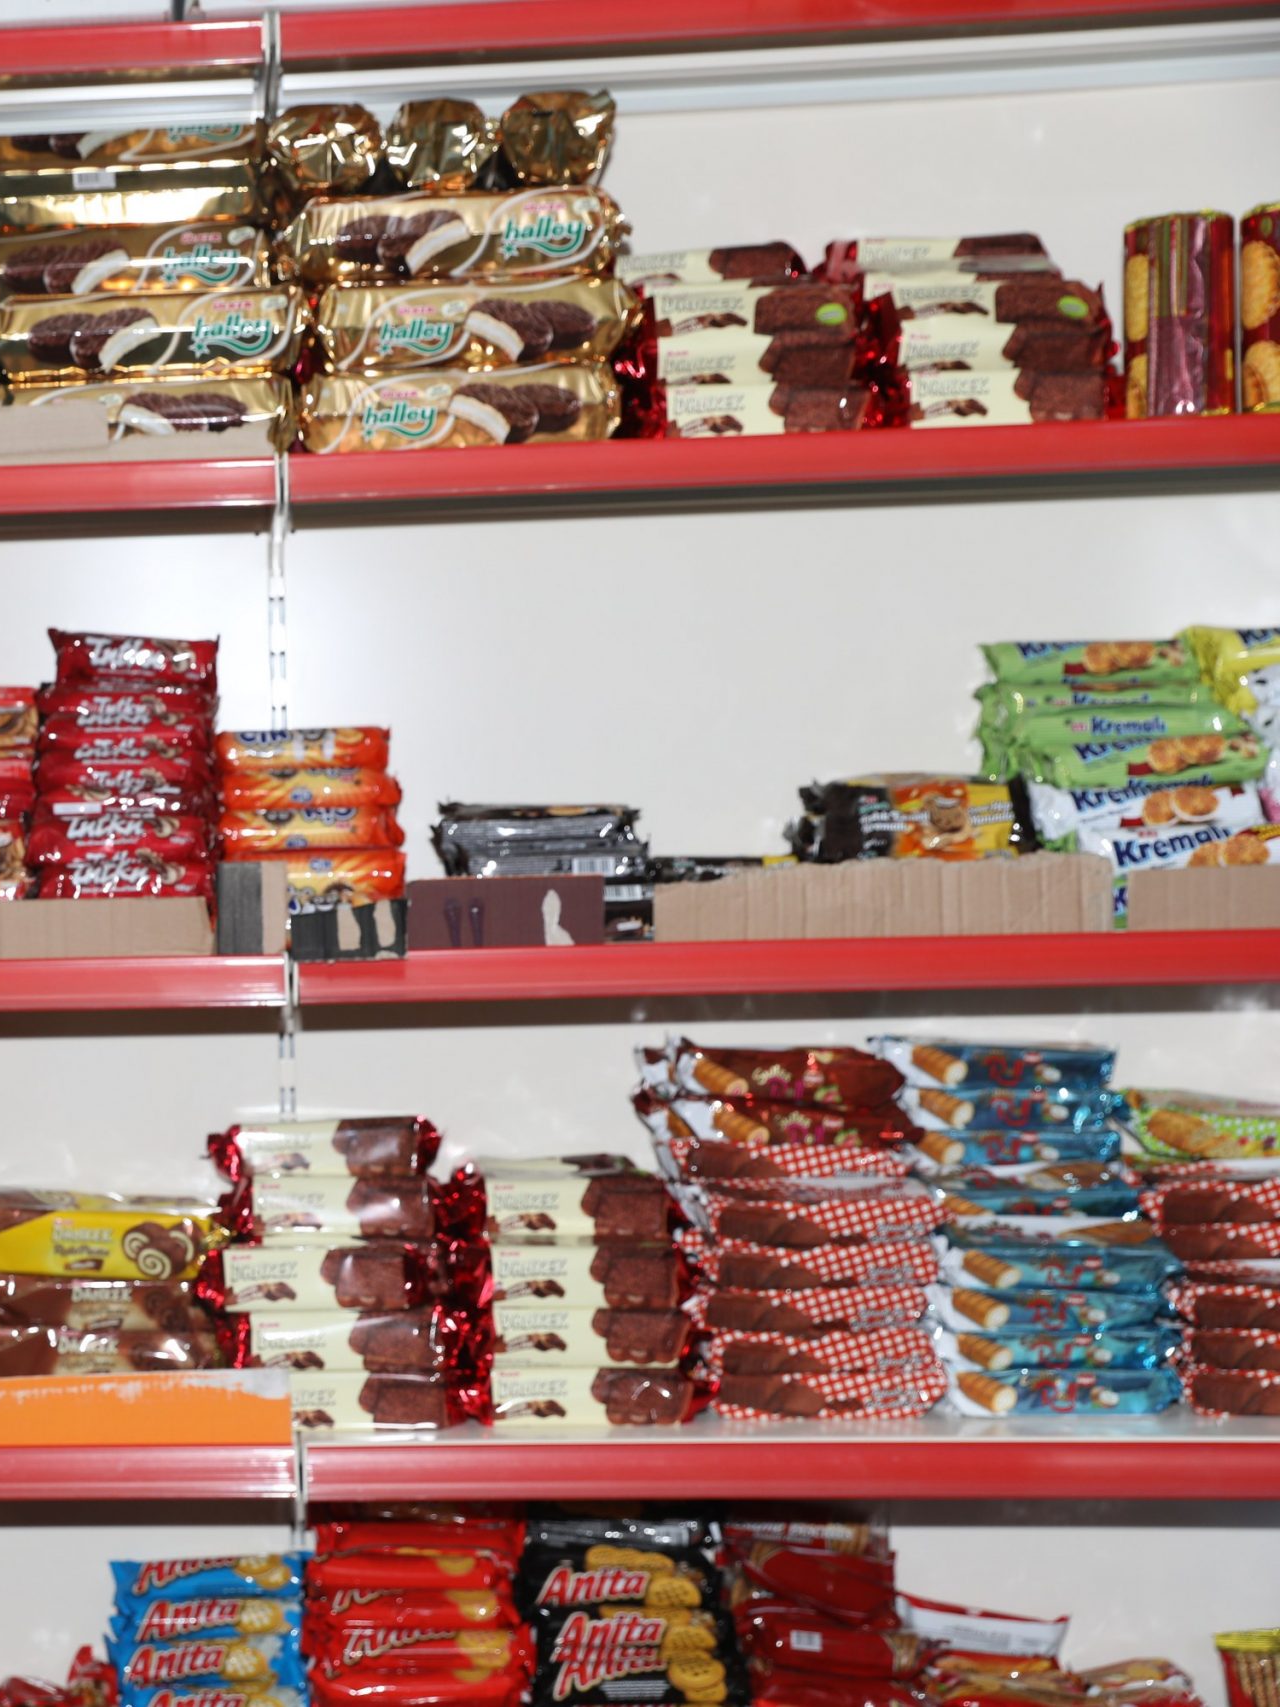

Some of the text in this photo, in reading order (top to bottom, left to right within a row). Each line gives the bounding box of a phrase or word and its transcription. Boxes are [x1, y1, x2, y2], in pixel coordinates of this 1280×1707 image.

[504, 215, 587, 258] halley
[194, 312, 272, 356] halley
[380, 317, 454, 355] halley
[363, 400, 438, 438] halley
[1112, 826, 1233, 868] Kremalı
[535, 1565, 651, 1607] Anita
[135, 1598, 243, 1643] Anita
[554, 1611, 668, 1650] Anita
[123, 1643, 228, 1684] Anita
